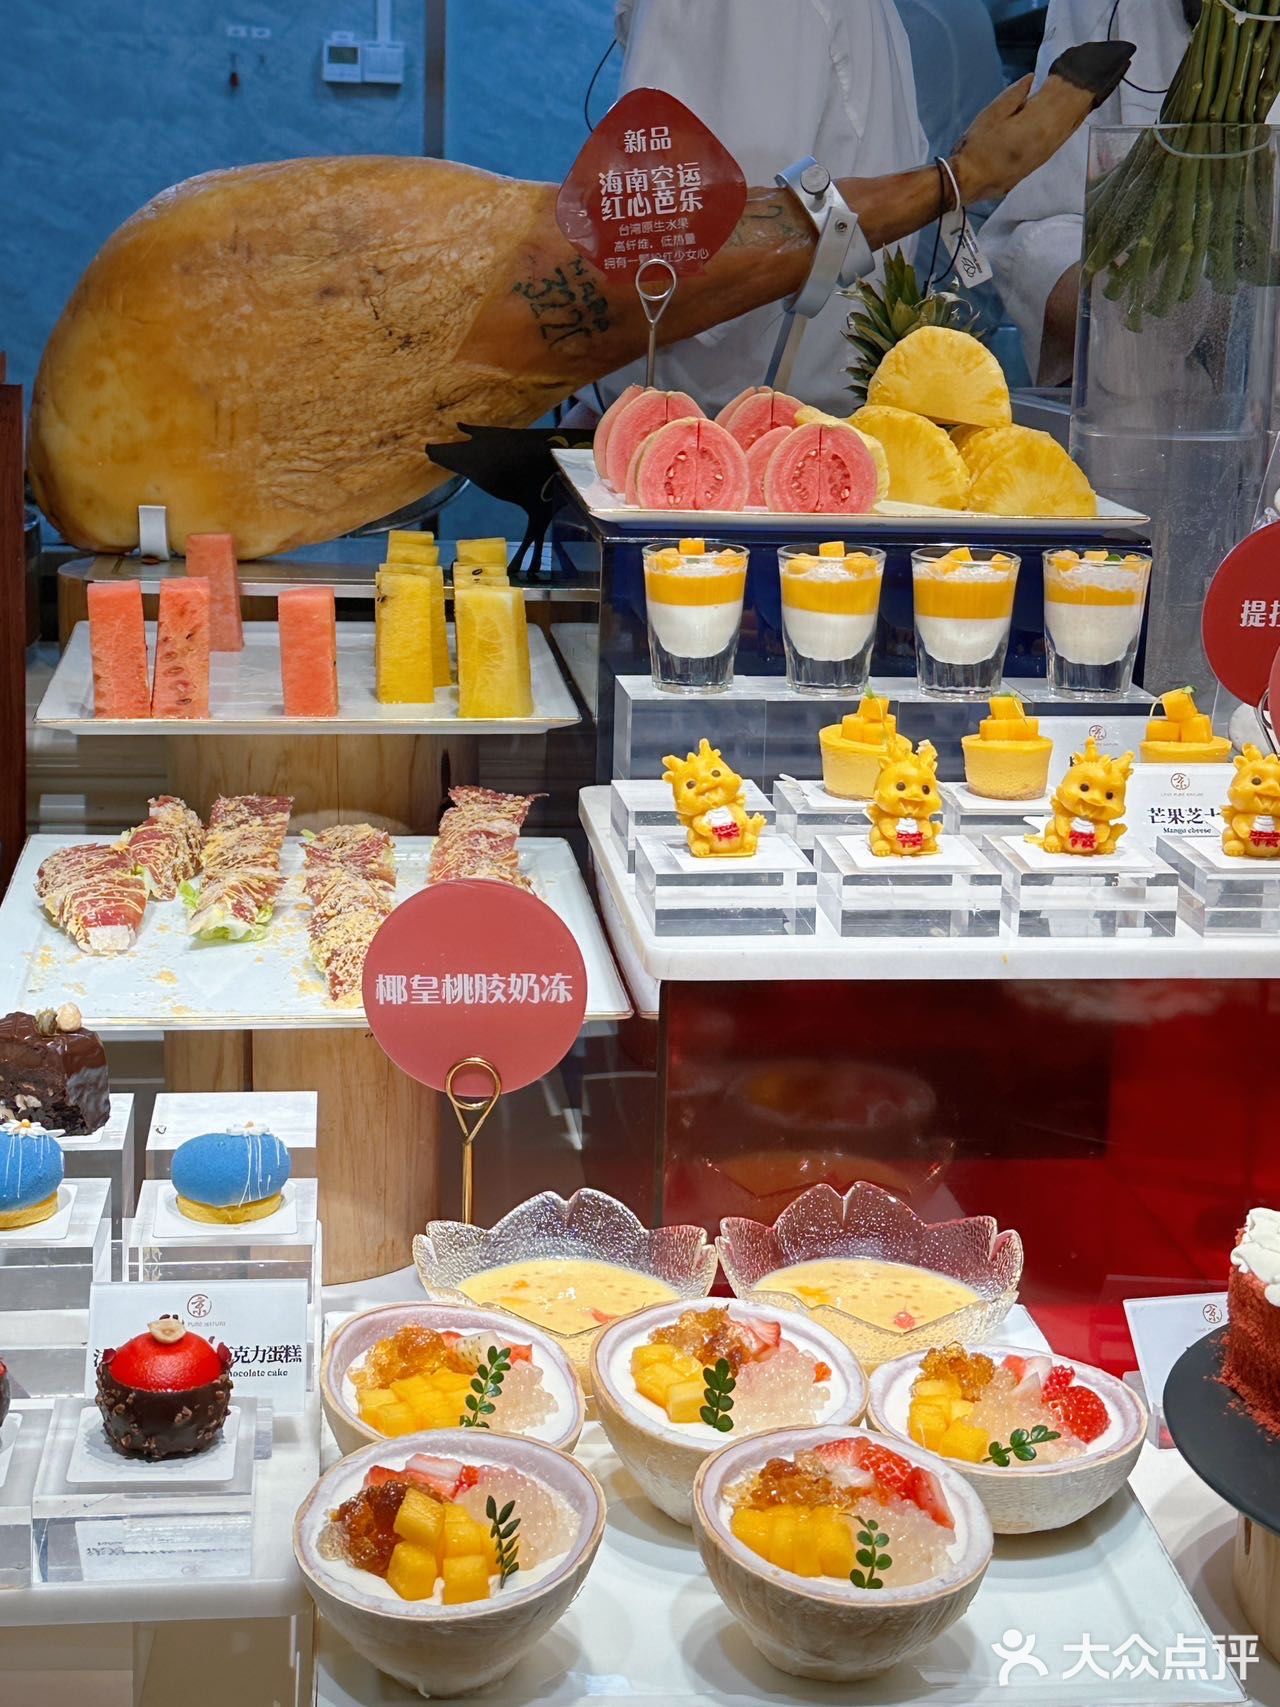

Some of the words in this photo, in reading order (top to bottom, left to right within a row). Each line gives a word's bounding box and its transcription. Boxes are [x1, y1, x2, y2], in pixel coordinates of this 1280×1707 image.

[624, 126, 672, 154] 新品
[599, 162, 702, 196] 海南空运
[601, 187, 704, 221] 红心芭乐
[618, 217, 689, 237] 台湾原生水果
[375, 972, 573, 1005] 椰皇桃胶奶冻
[229, 1344, 302, 1364] 克力蛋糕
[267, 1368, 288, 1376] cake
